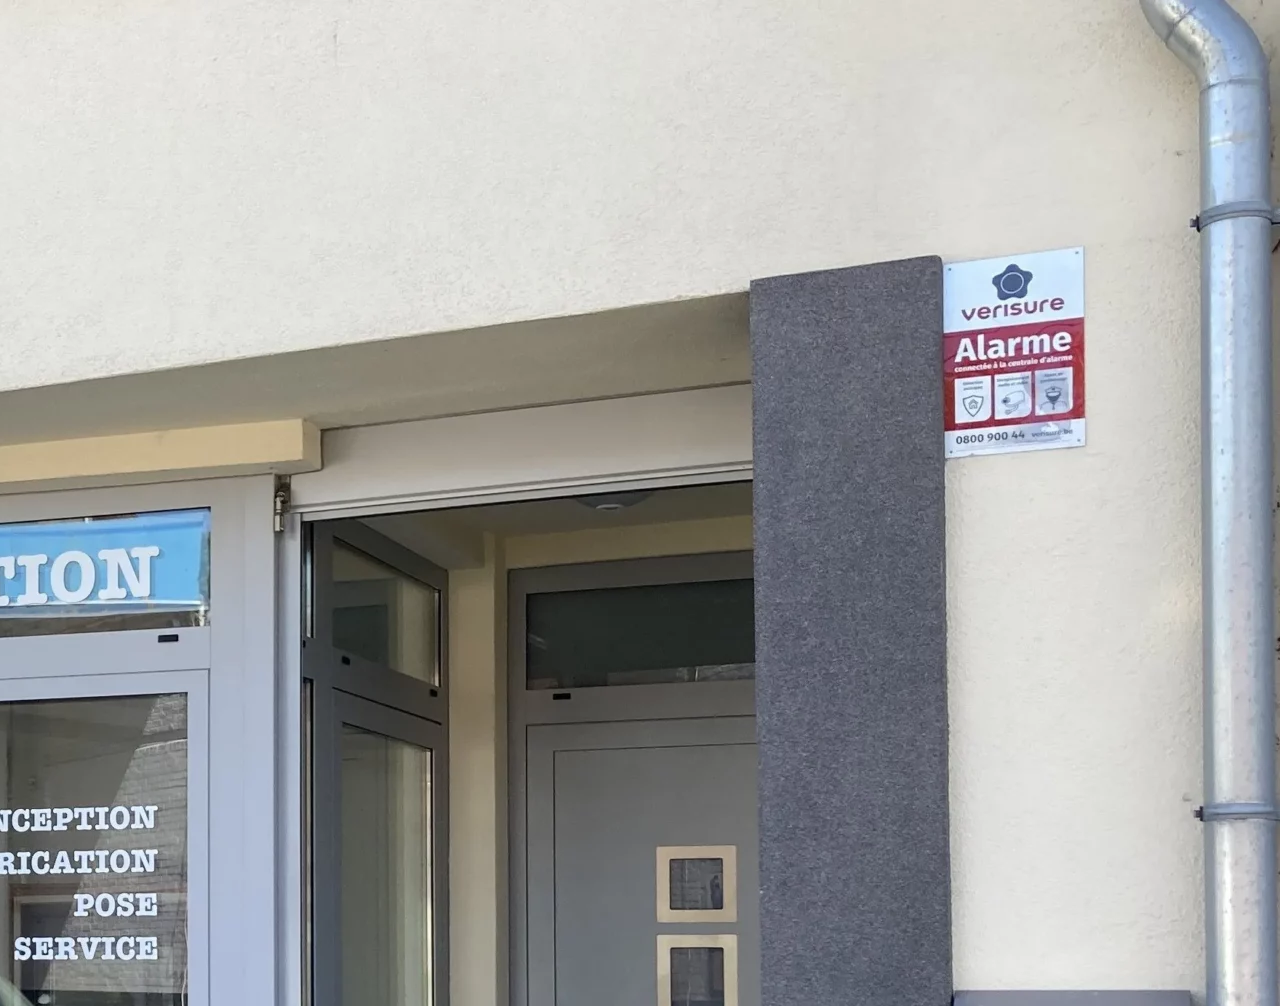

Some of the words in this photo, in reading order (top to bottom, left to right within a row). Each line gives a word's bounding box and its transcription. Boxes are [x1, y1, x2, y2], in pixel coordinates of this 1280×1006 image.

[961, 297, 1065, 321] verisure
[954, 331, 1072, 362] Alarme
[956, 434, 984, 445] 0800
[987, 432, 1008, 442] 900
[1011, 430, 1025, 439] 44
[73, 893, 157, 917] POSE
[14, 936, 158, 961] SERVICE
